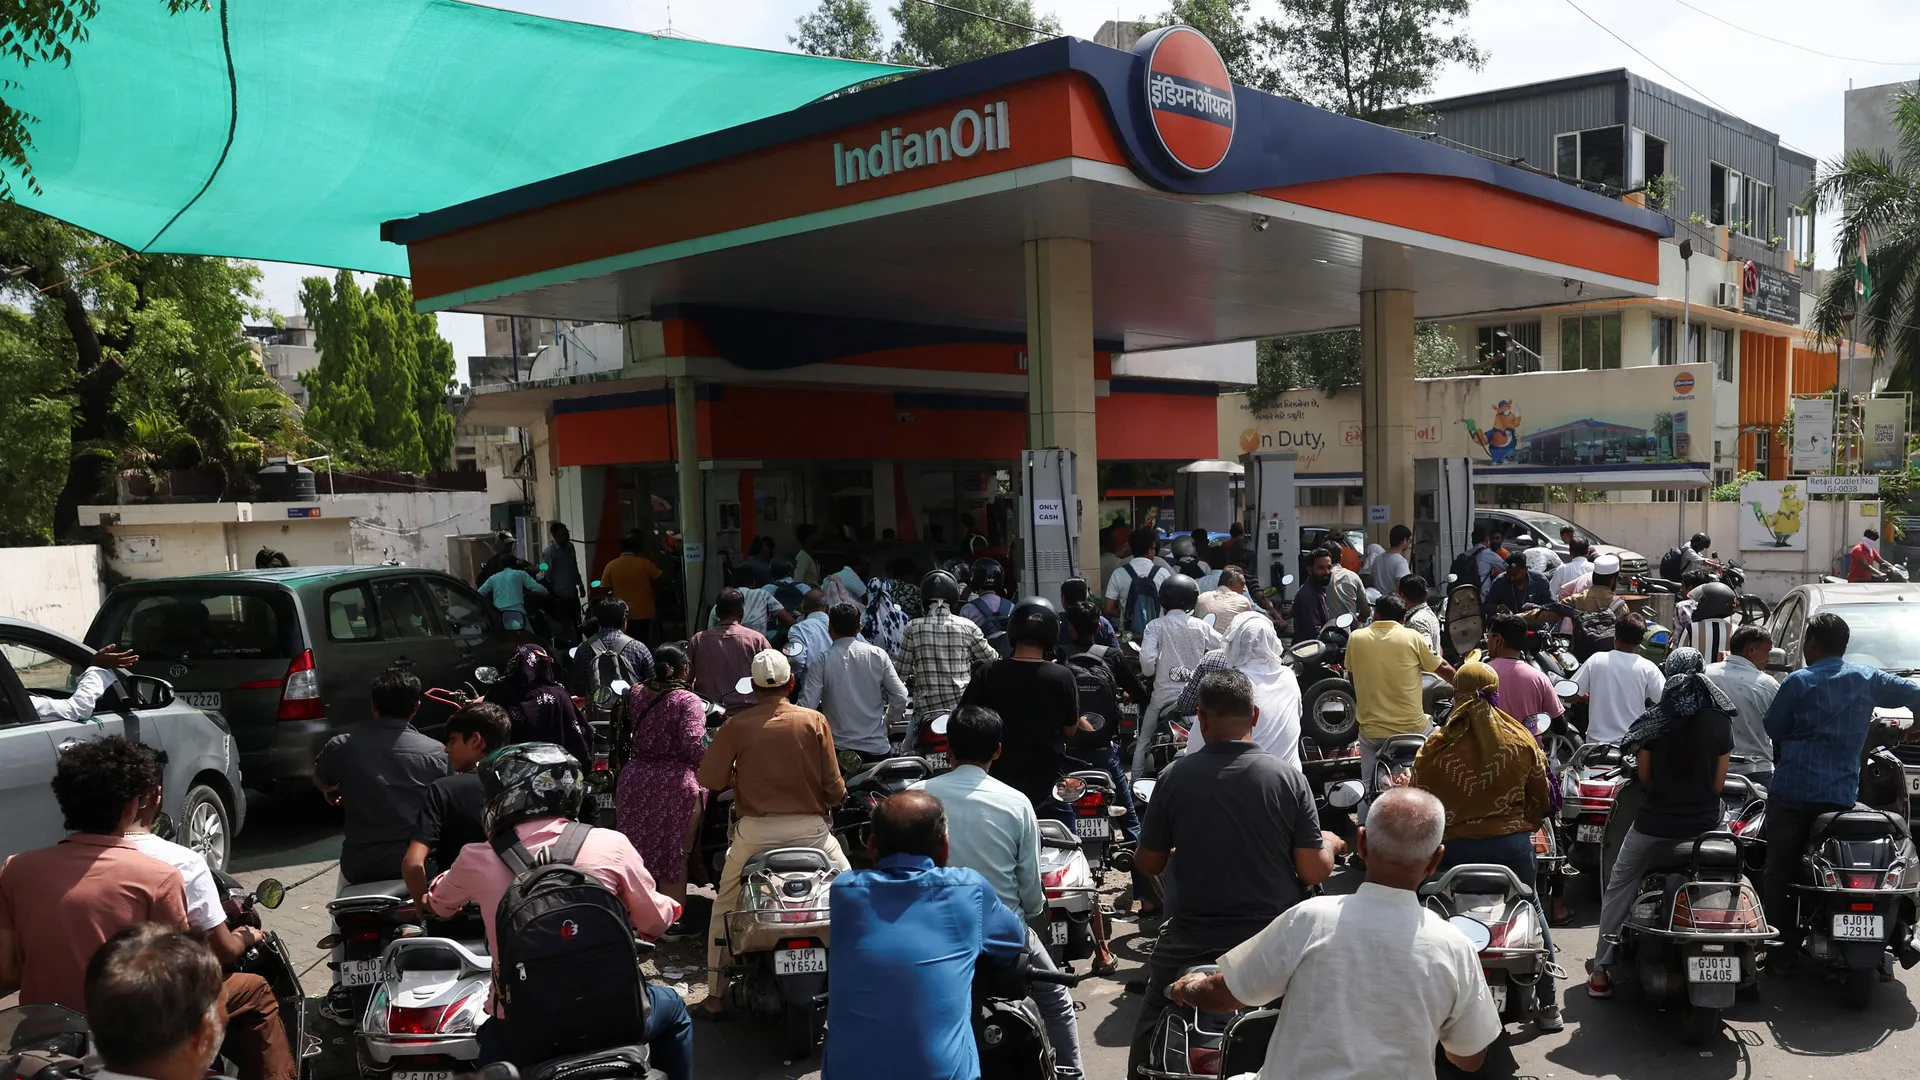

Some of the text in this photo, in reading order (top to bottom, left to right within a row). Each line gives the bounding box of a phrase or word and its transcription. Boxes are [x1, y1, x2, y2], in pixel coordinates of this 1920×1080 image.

[1151, 75, 1232, 120] इंडियनऑयल
[834, 101, 1010, 186] IndianOil
[1279, 431, 1325, 450] Duty,
[1810, 478, 1833, 486] Retail
[1834, 478, 1860, 486] Outlet
[1843, 927, 1875, 937] J2914
[790, 949, 817, 961] GJ01
[1698, 958, 1731, 969] GJ01J
[1699, 970, 1732, 981] A6405
